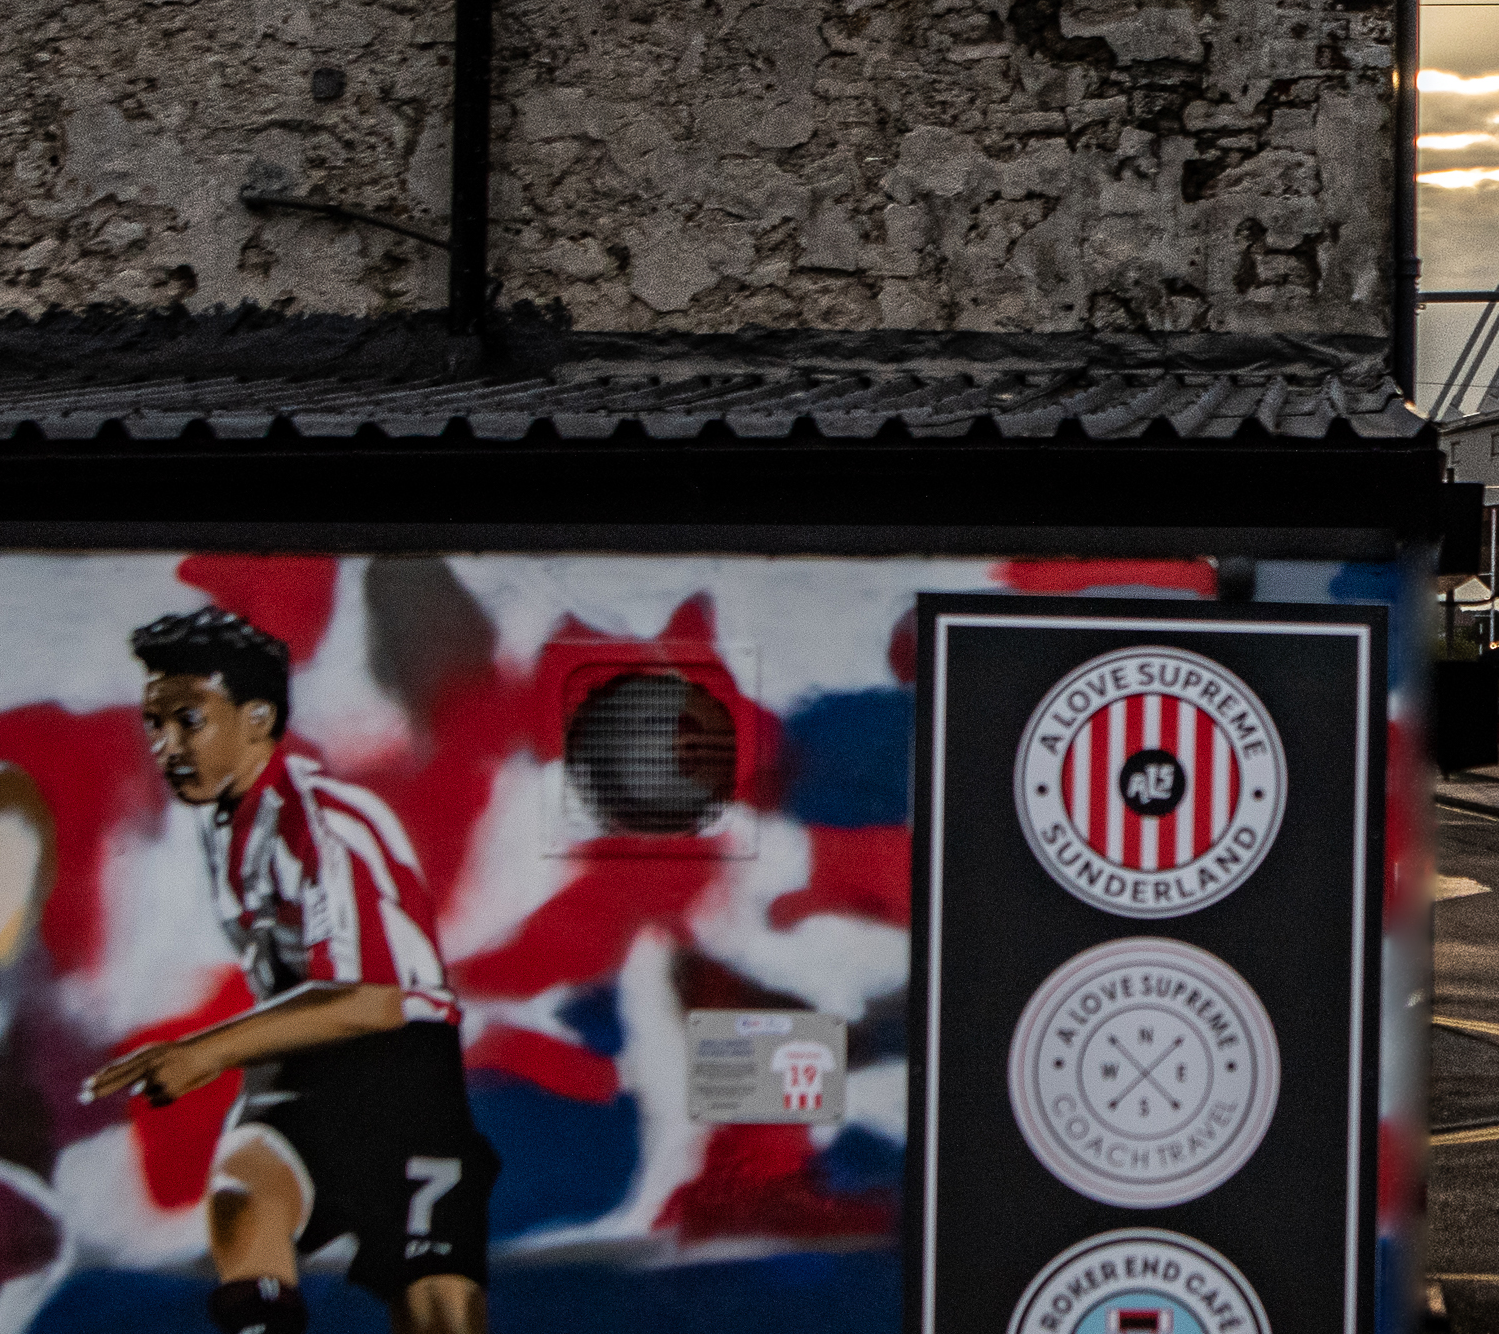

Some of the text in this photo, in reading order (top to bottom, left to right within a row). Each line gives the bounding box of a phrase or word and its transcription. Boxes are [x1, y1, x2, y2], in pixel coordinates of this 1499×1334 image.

[1040, 662, 1267, 759] A LOVE SUPREME
[1042, 823, 1257, 903] SUNDERLAND
[1057, 974, 1239, 1051] A LOVE SUPREME
[1138, 1027, 1154, 1045] N
[791, 1064, 818, 1088] 19
[1052, 1092, 1239, 1168] COACH TRAVEL
[405, 1155, 462, 1237] 7
[1040, 1260, 1120, 1332] ROKER
[1125, 1254, 1183, 1282] END
